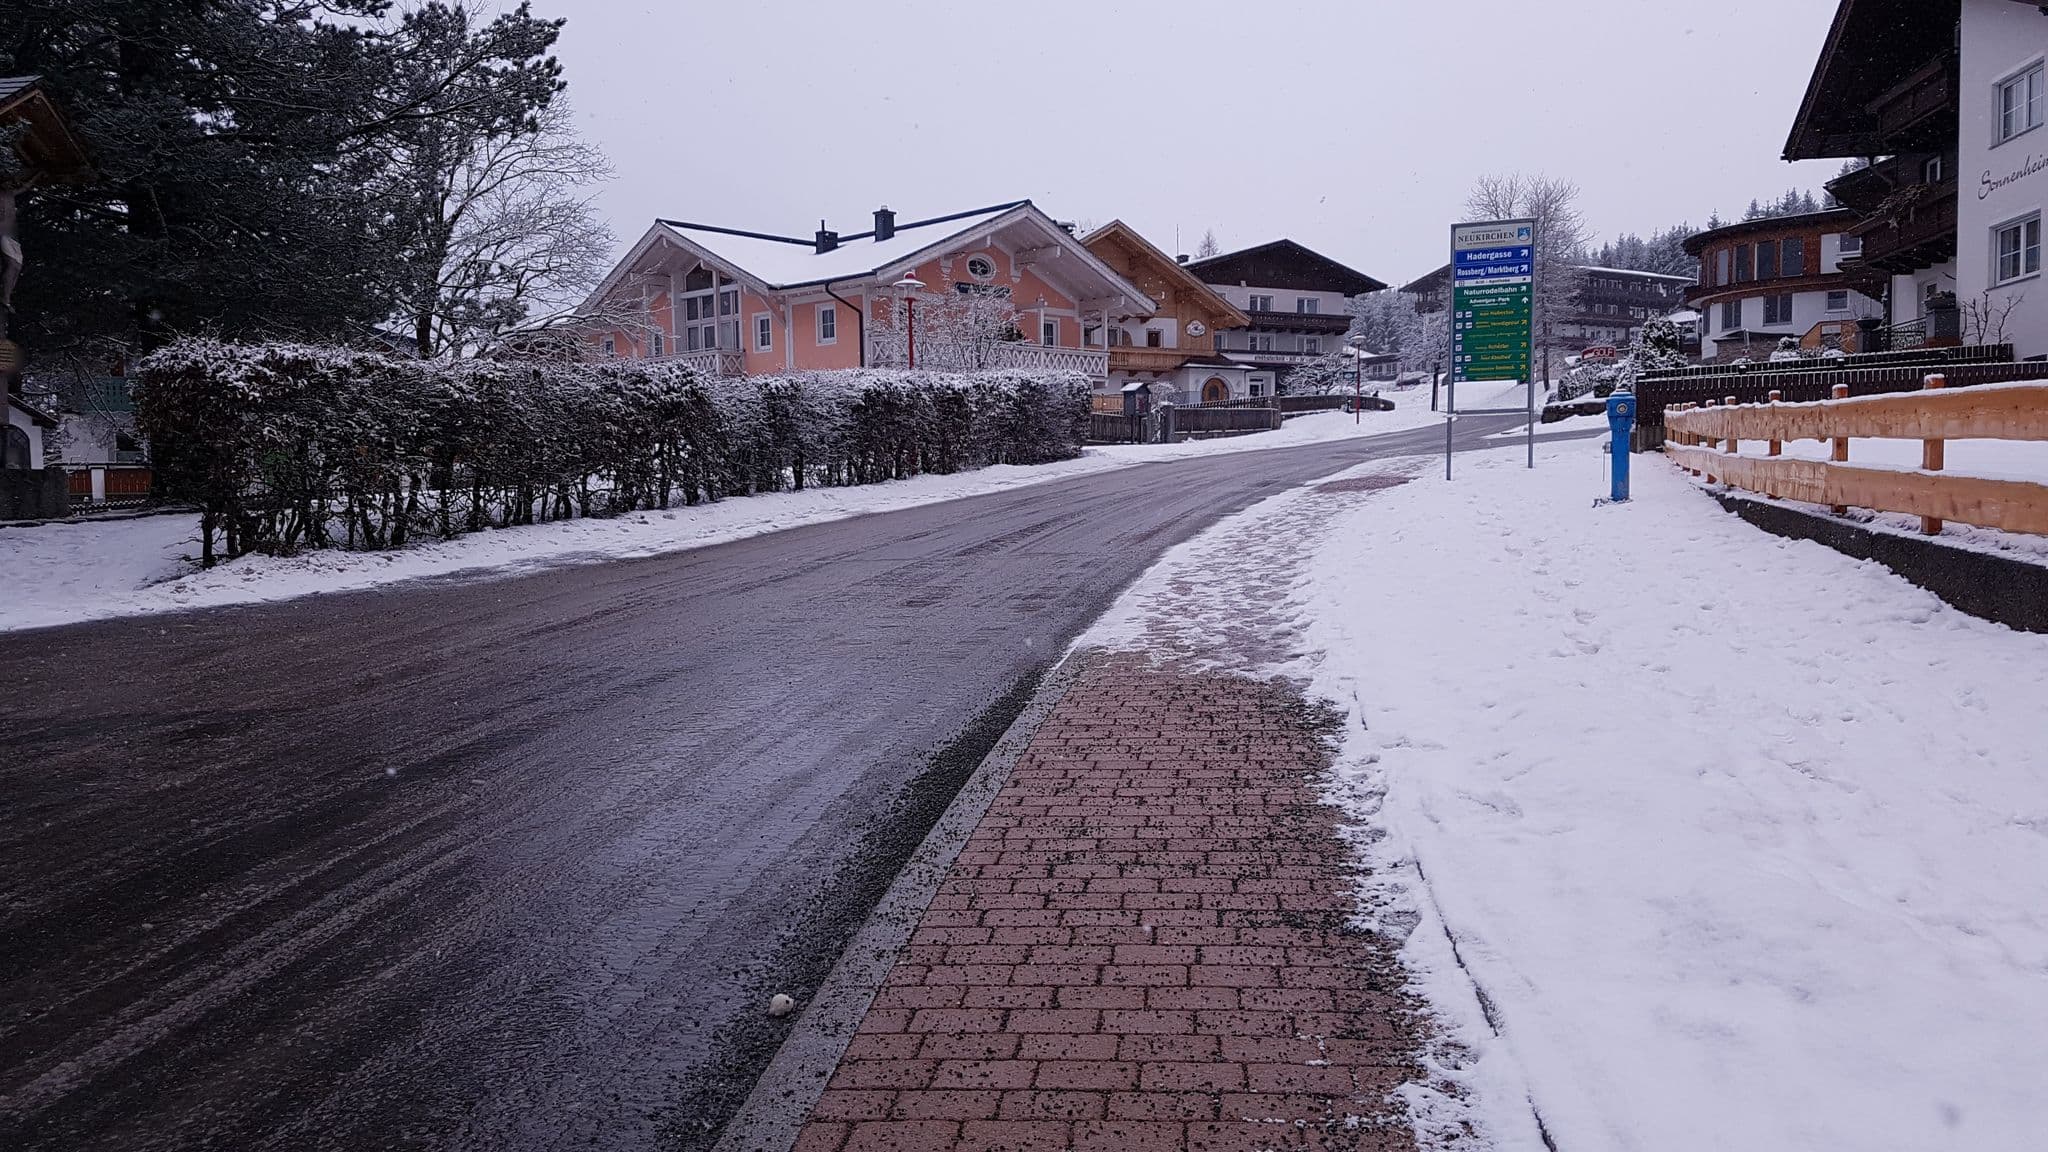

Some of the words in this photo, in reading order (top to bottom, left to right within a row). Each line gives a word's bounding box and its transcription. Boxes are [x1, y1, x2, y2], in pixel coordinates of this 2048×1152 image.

[1457, 231, 1515, 243] NEUKIRCHEN
[1467, 251, 1512, 260] Hadergasse
[1464, 287, 1517, 295] Naturrodelbahn
[1593, 348, 1613, 357] GOLF
